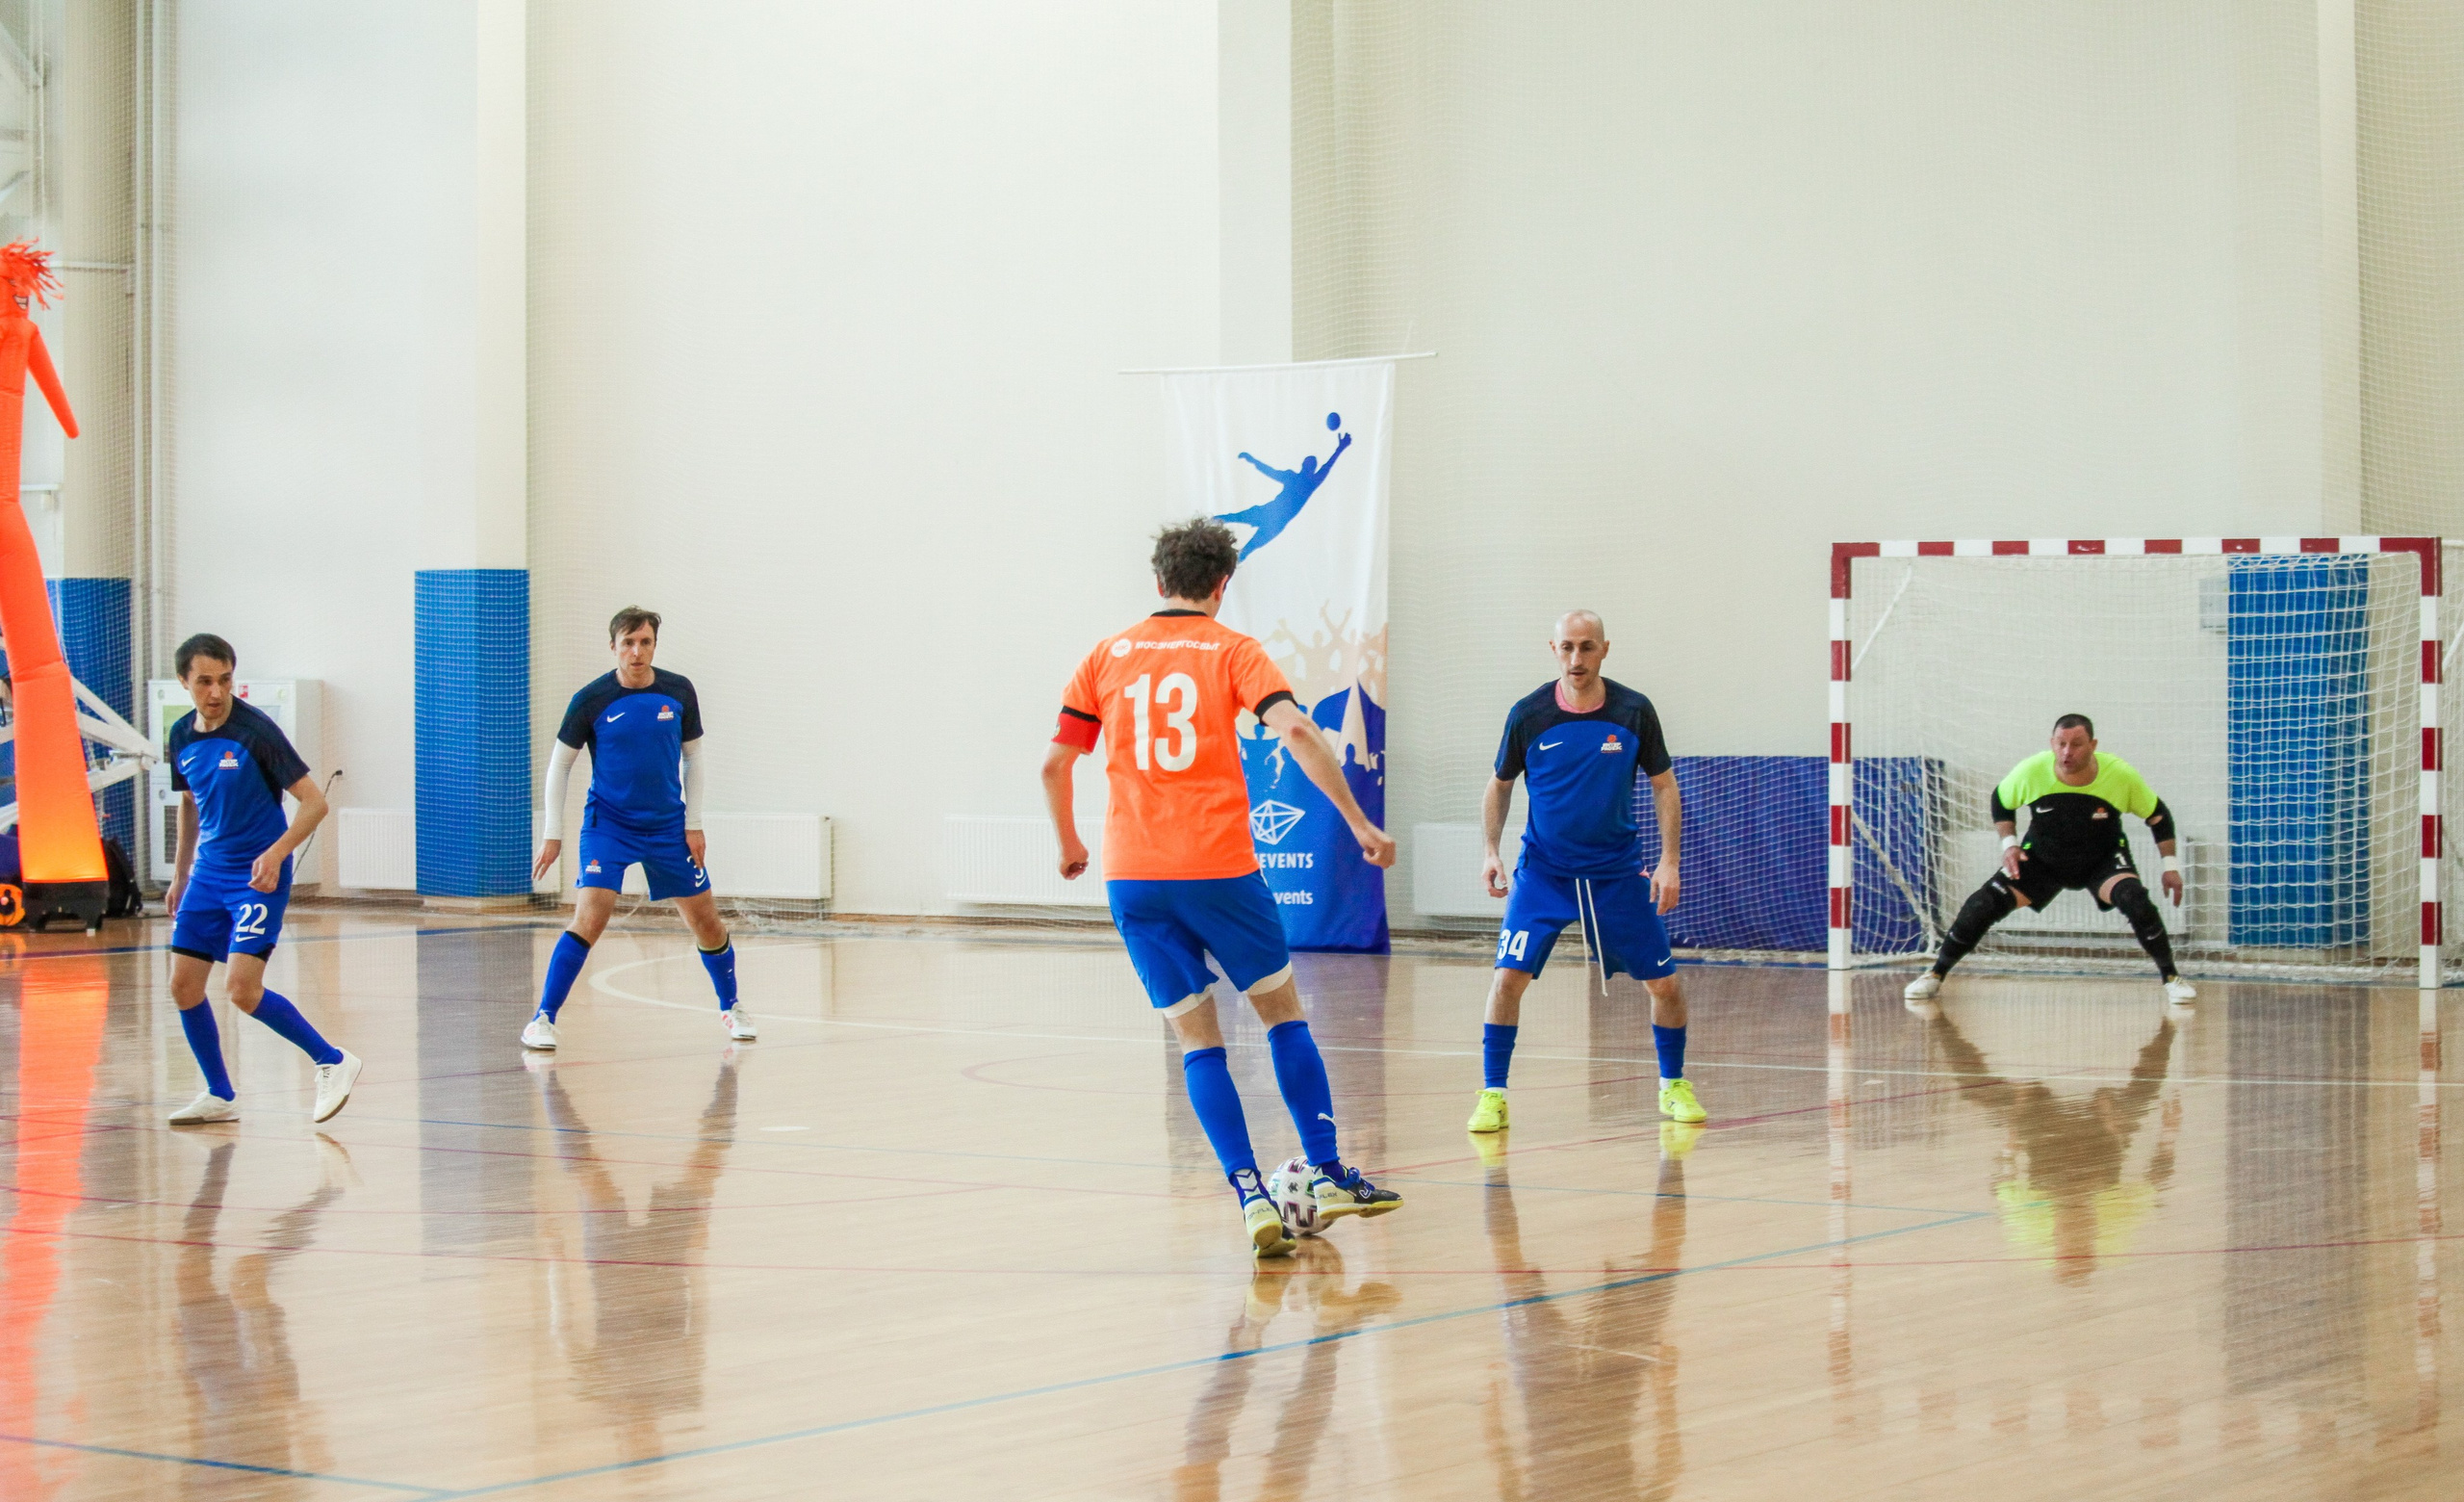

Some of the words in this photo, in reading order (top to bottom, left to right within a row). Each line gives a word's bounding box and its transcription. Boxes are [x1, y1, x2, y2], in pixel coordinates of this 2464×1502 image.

[1136, 640, 1220, 651] МОСЭНЕРГОСБЫТ
[1124, 672, 1197, 772] 13
[1254, 853, 1314, 868] EVENTS
[1272, 890, 1314, 905] vents
[235, 903, 269, 935] 22
[1497, 928, 1529, 962] 34
